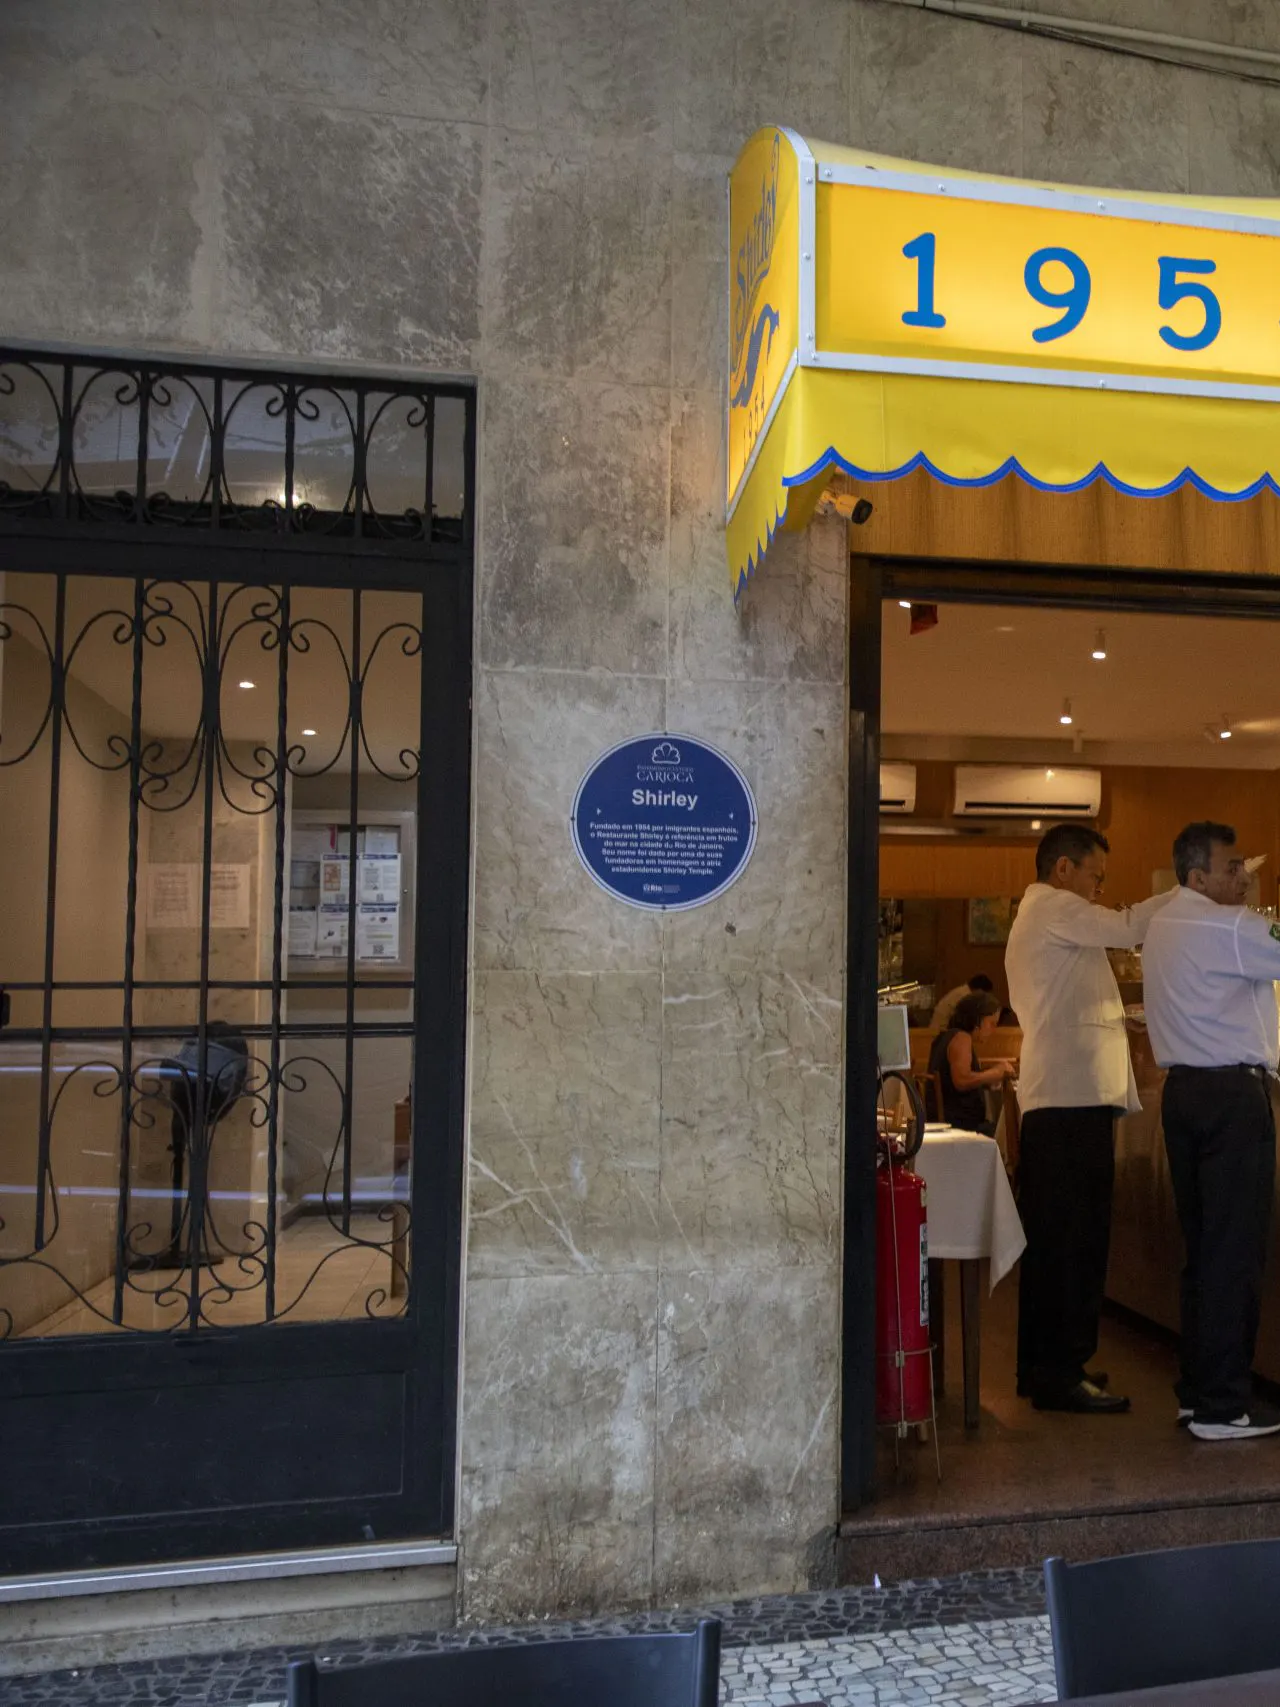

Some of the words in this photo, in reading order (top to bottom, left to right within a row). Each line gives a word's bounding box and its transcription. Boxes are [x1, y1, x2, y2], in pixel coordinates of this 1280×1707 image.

[636, 771, 694, 783] CARIOCA
[632, 788, 698, 811] Shirley
[590, 823, 621, 831] Fundado
[652, 825, 664, 833] por
[665, 825, 701, 834] imigrantes
[597, 831, 638, 839] Restaurante
[640, 832, 664, 841] Shirley
[671, 833, 705, 841] referência
[718, 834, 738, 842] frutos
[637, 848, 647, 856] foi
[648, 849, 666, 857] dado
[667, 850, 679, 858] por
[657, 858, 700, 867] homenagem
[706, 859, 722, 867] atriz
[611, 866, 662, 874] estadunidense
[663, 866, 687, 875] Shirley
